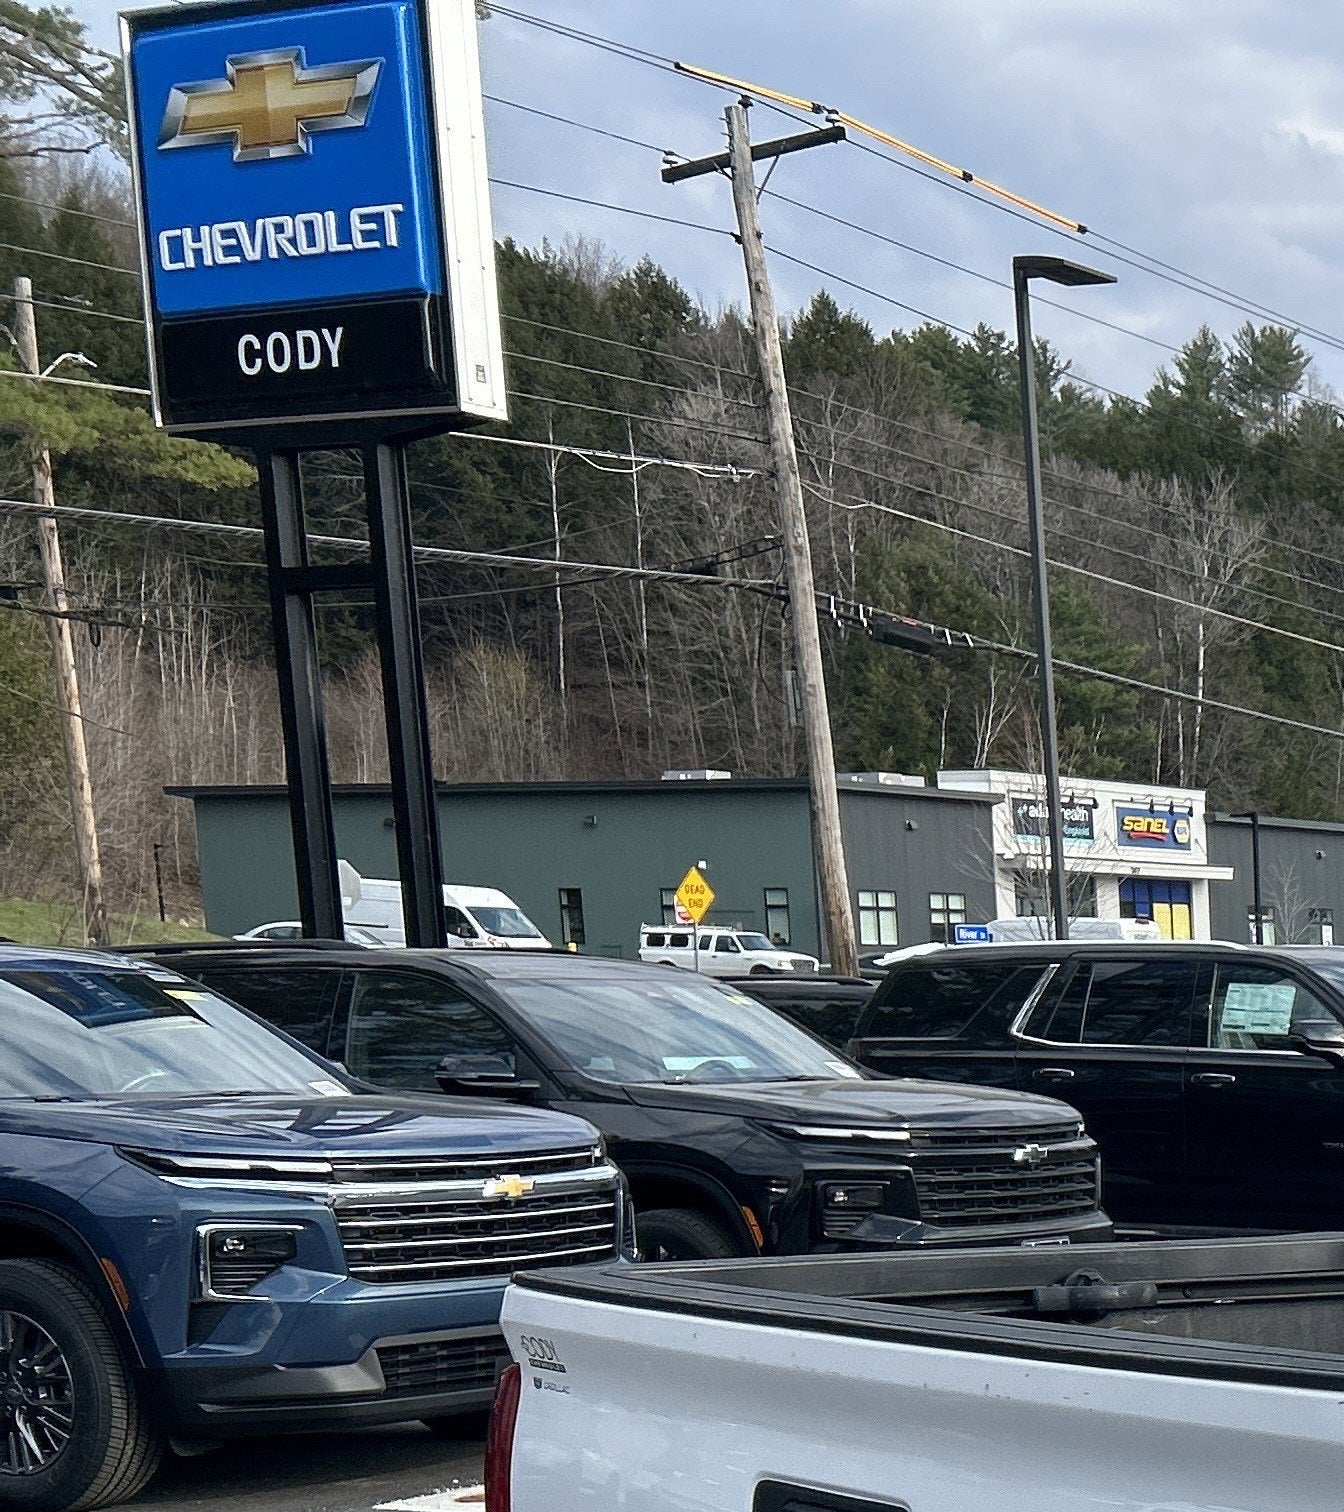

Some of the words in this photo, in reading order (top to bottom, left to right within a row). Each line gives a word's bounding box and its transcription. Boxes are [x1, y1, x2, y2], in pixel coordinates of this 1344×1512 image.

[158, 203, 403, 271] CHEVROLET
[237, 326, 344, 376] CODY
[685, 884, 705, 895] DEAD
[688, 898, 703, 908] END
